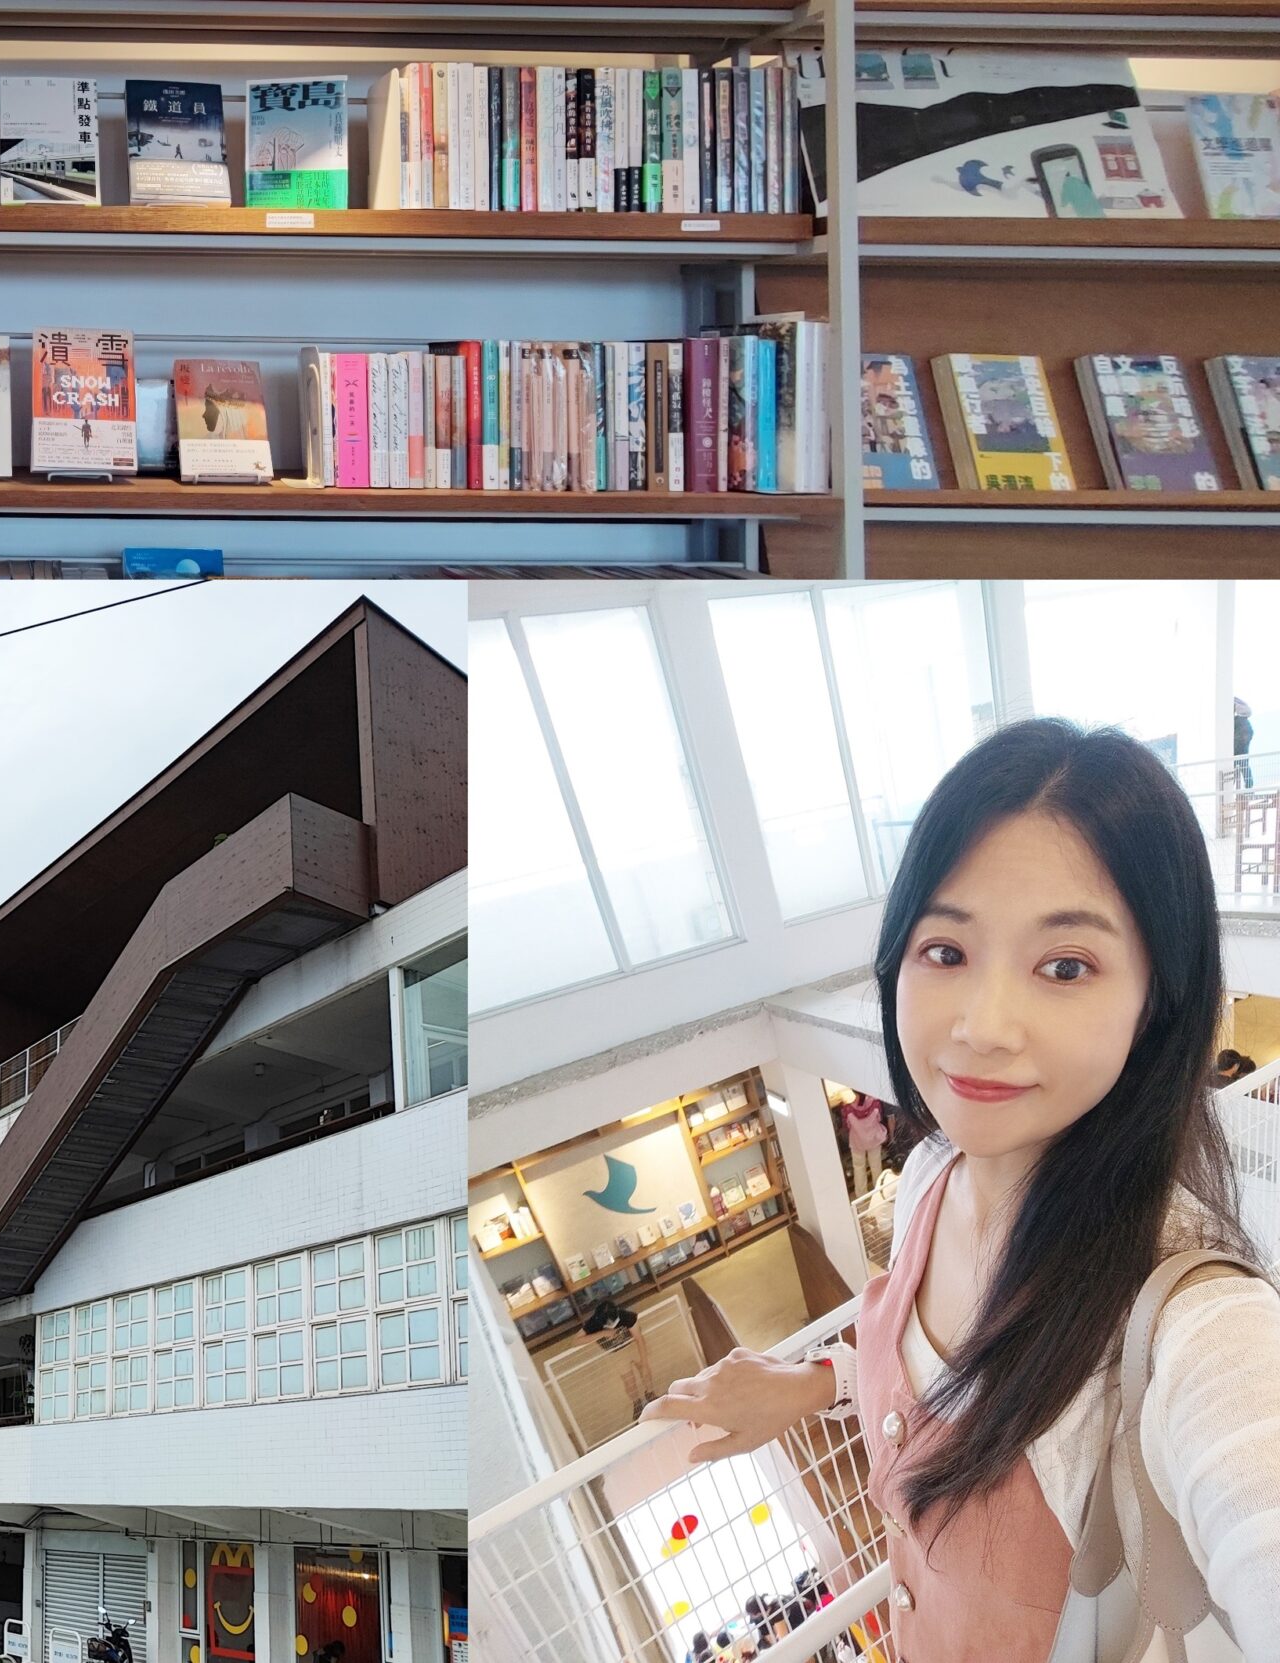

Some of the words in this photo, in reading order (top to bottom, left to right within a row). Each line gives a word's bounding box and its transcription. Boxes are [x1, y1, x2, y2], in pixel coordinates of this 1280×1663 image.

[76, 81, 92, 144] 準點發車
[142, 98, 207, 116] 鐵道員
[200, 363, 212, 373] La
[60, 374, 111, 390] SNOW
[52, 391, 120, 408] CRASH
